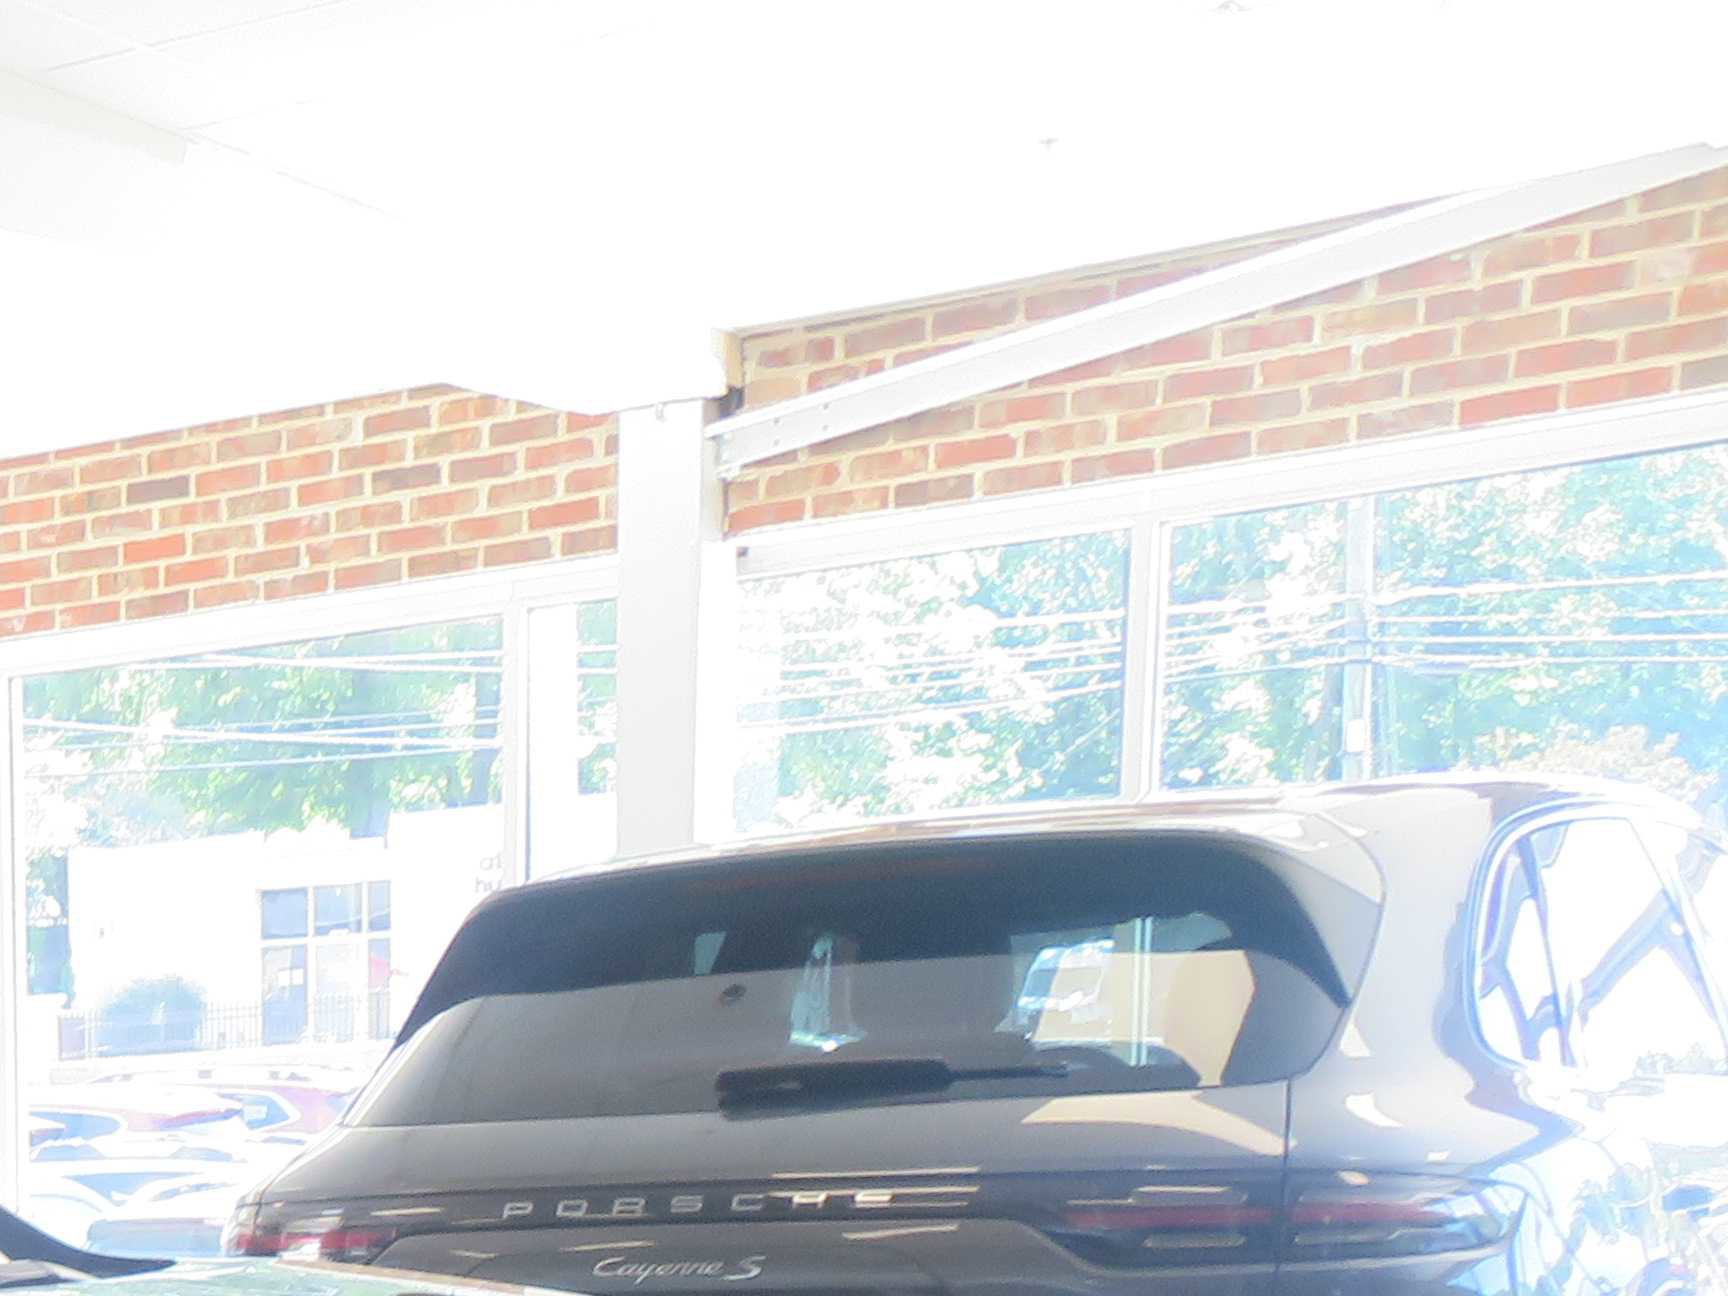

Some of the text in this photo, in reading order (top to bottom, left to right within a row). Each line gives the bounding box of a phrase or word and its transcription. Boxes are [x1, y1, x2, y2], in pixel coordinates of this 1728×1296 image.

[501, 1189, 895, 1220] PORSCHE
[592, 1254, 767, 1286] Cayenne S
